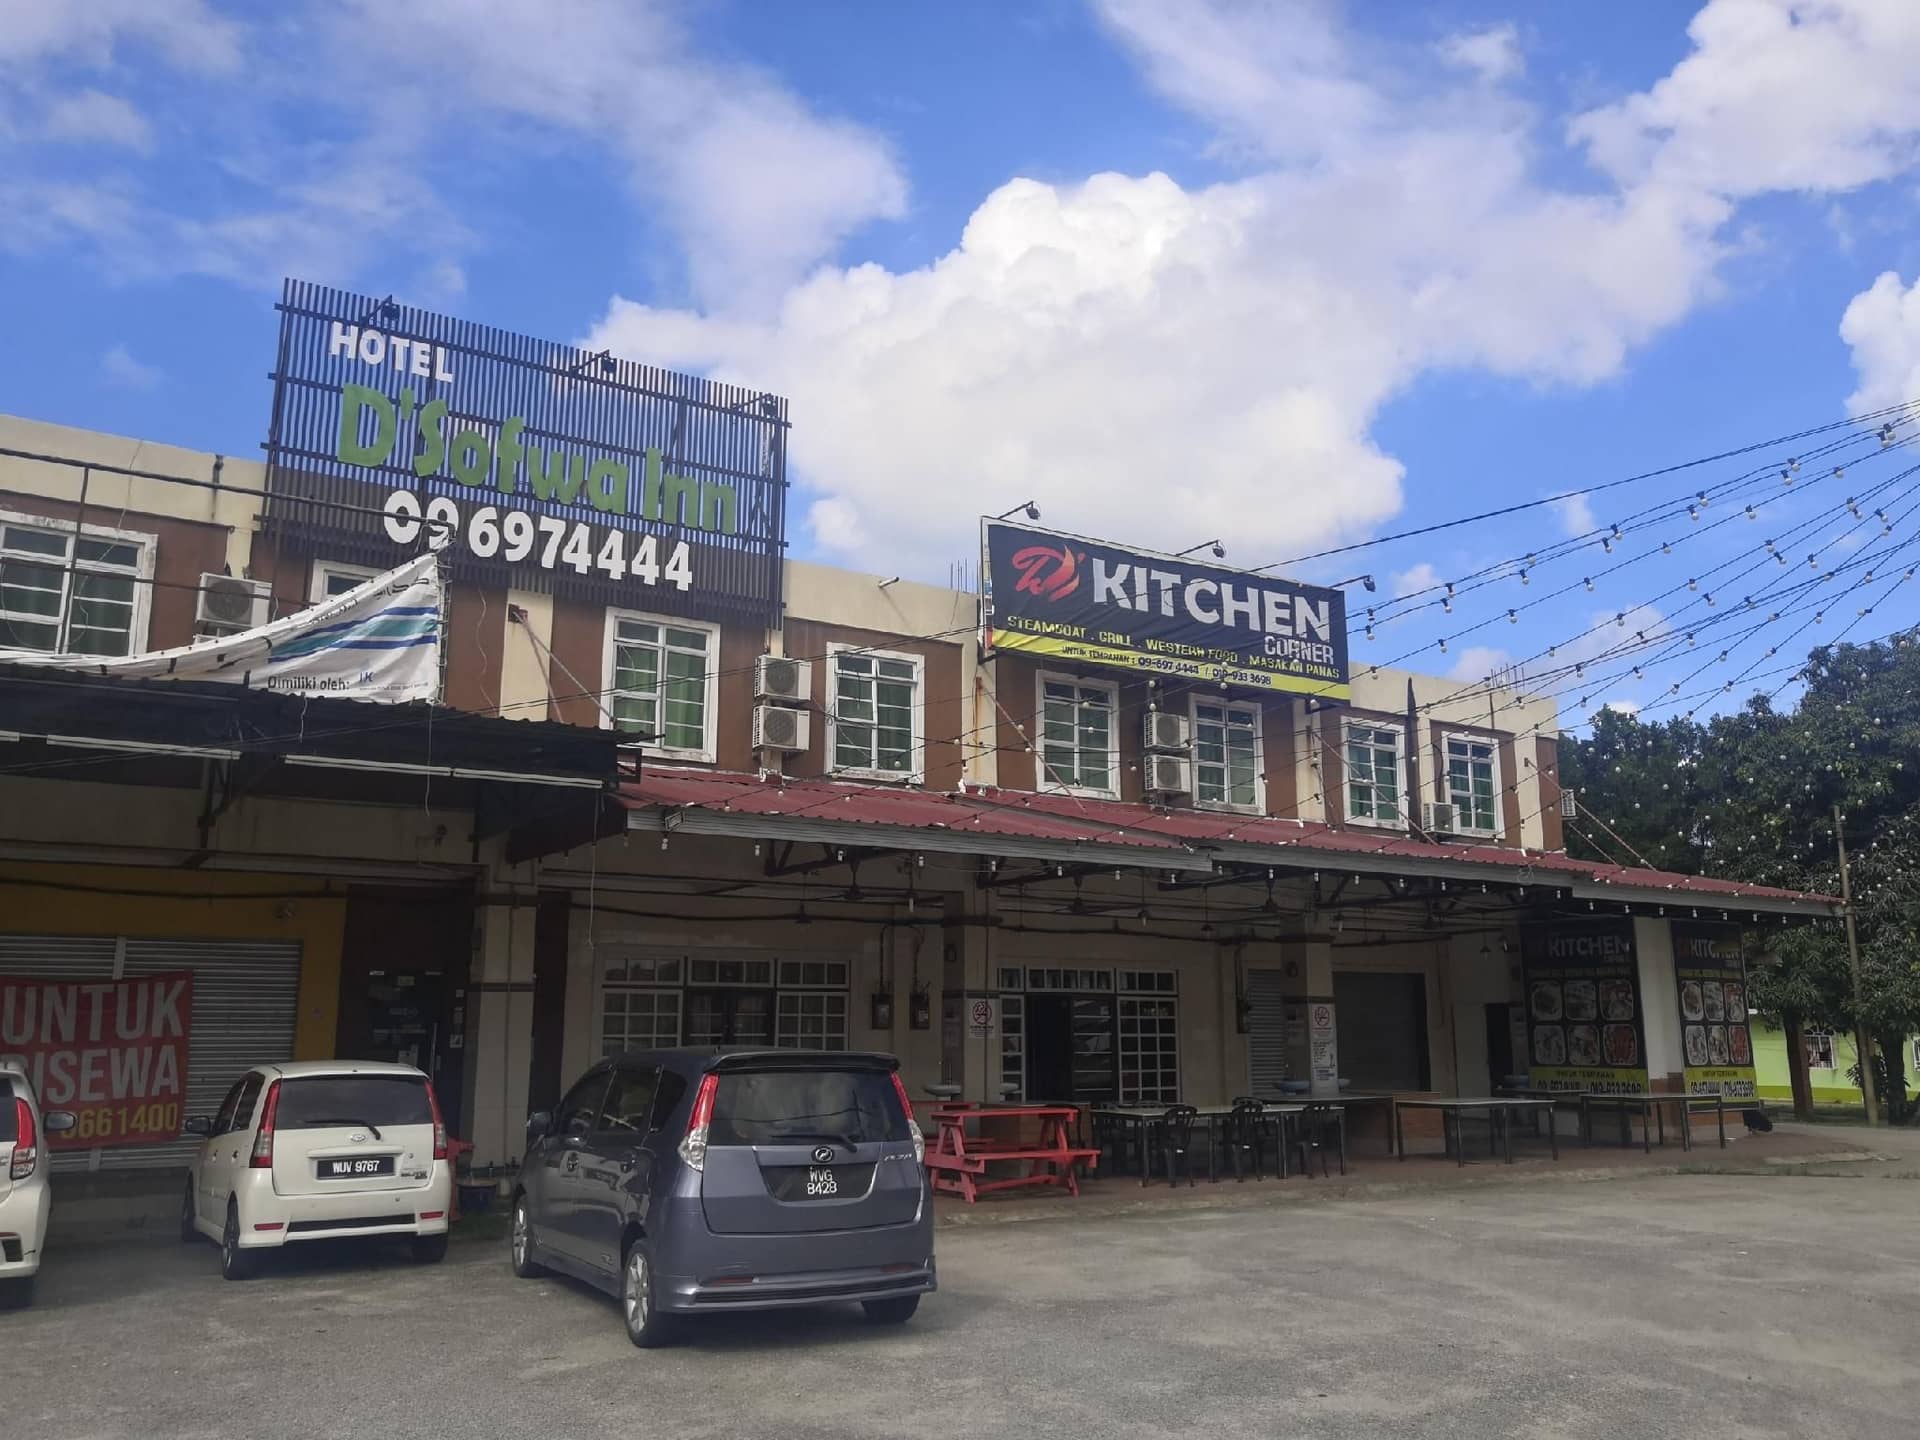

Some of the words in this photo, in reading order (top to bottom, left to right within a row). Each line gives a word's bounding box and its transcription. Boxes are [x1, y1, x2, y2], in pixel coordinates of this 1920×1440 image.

[329, 322, 453, 382] HOTEL
[337, 382, 628, 516] D'Sofwa
[642, 447, 738, 535] Inn
[384, 490, 459, 549] 09
[468, 506, 693, 591] 6974444
[1093, 558, 1329, 642] KITCHEN
[1007, 615, 1087, 639] STEAMBOAT
[1099, 631, 1134, 647] GRILL
[1146, 639, 1205, 657] WESTERN
[1208, 649, 1238, 663] FOOD
[1249, 654, 1303, 673] MASAKAN
[1306, 663, 1340, 679] PANAS
[1264, 635, 1334, 665] CORNER
[268, 676, 316, 690] Dimiliki
[320, 679, 350, 691] oleh:
[1550, 935, 1631, 957] KITCHEN
[2, 980, 187, 1045] UNTUK
[60, 1103, 178, 1139] 661400
[332, 1160, 352, 1174] WUV
[355, 1160, 380, 1173] 9767
[809, 1169, 833, 1182] WVG
[807, 1181, 838, 1195] 8428
